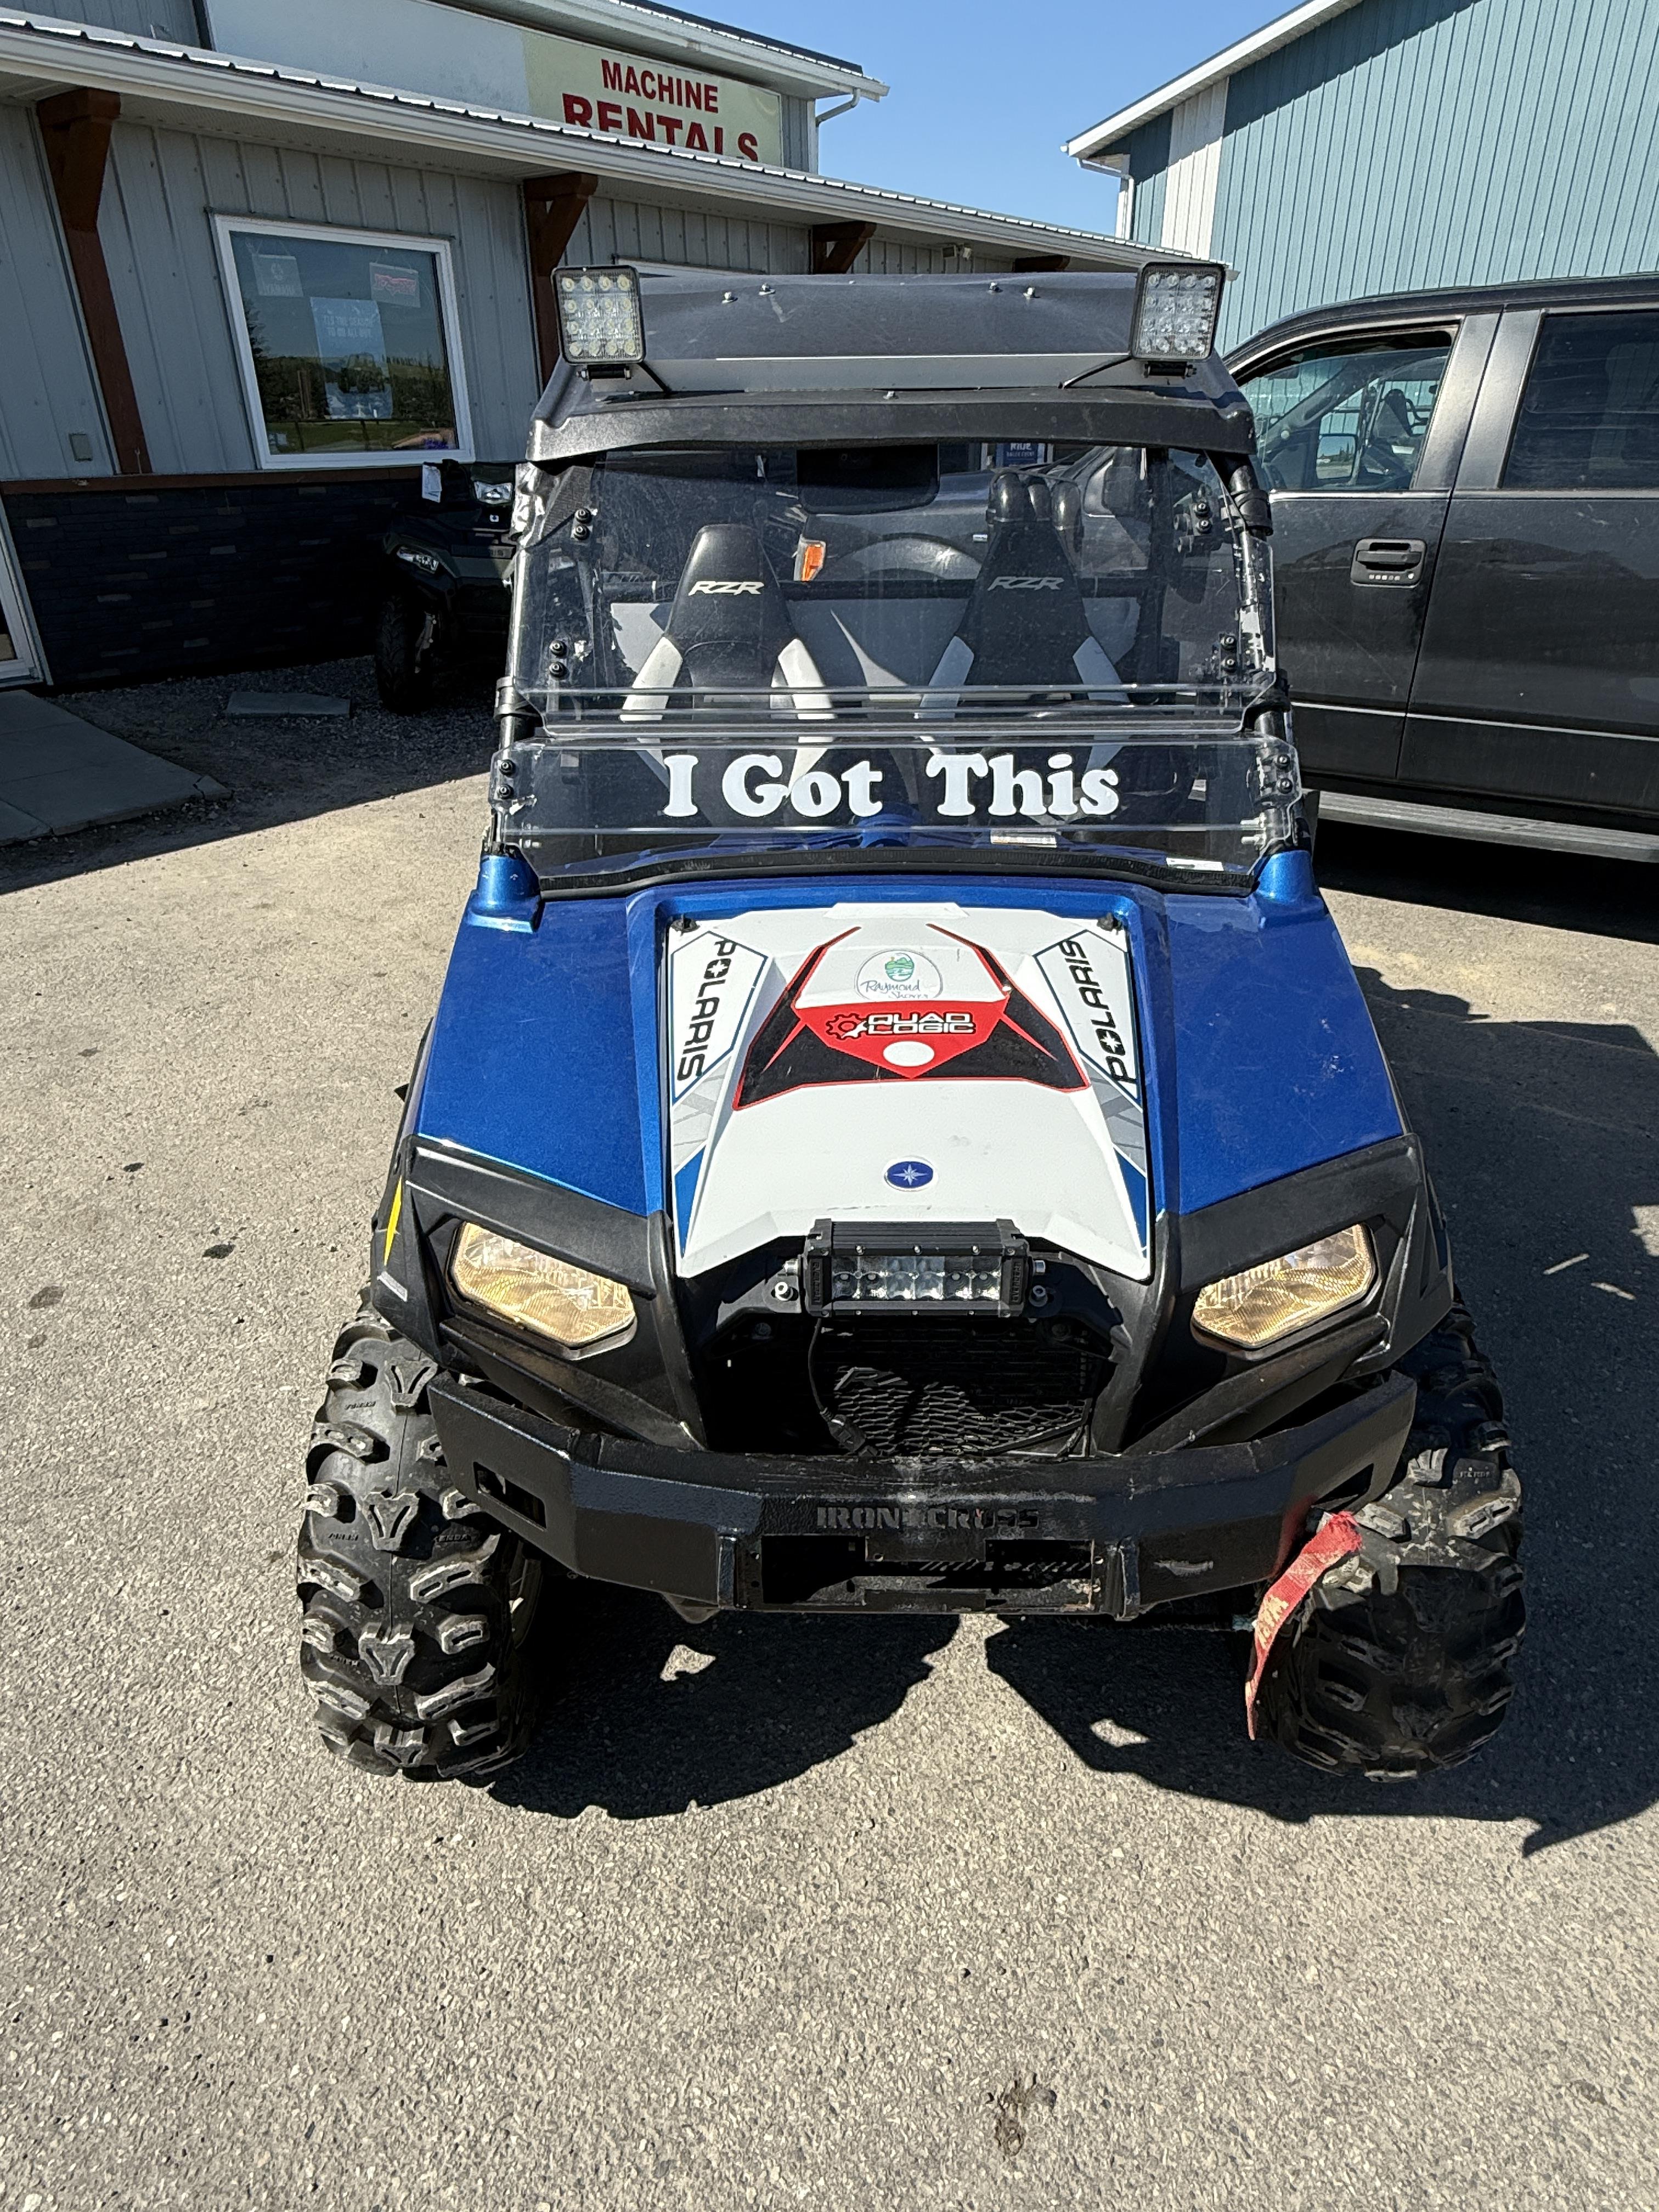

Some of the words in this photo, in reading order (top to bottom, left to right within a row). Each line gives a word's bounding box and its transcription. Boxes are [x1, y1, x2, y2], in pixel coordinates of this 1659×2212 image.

[601, 58, 719, 114] MACHINE
[688, 580, 765, 596] RZR
[987, 575, 1065, 591] RZR
[663, 754, 698, 817] I
[722, 754, 883, 818] Got
[924, 753, 1119, 817] This
[860, 979, 921, 994] Raymond
[676, 938, 738, 1081] POLARIS
[868, 1013, 970, 1025] QUAD
[1059, 939, 1137, 1084] POLARIS
[868, 1023, 974, 1035] LOGIC
[817, 1506, 900, 1530] IRON
[927, 1506, 1039, 1530] CROSS
